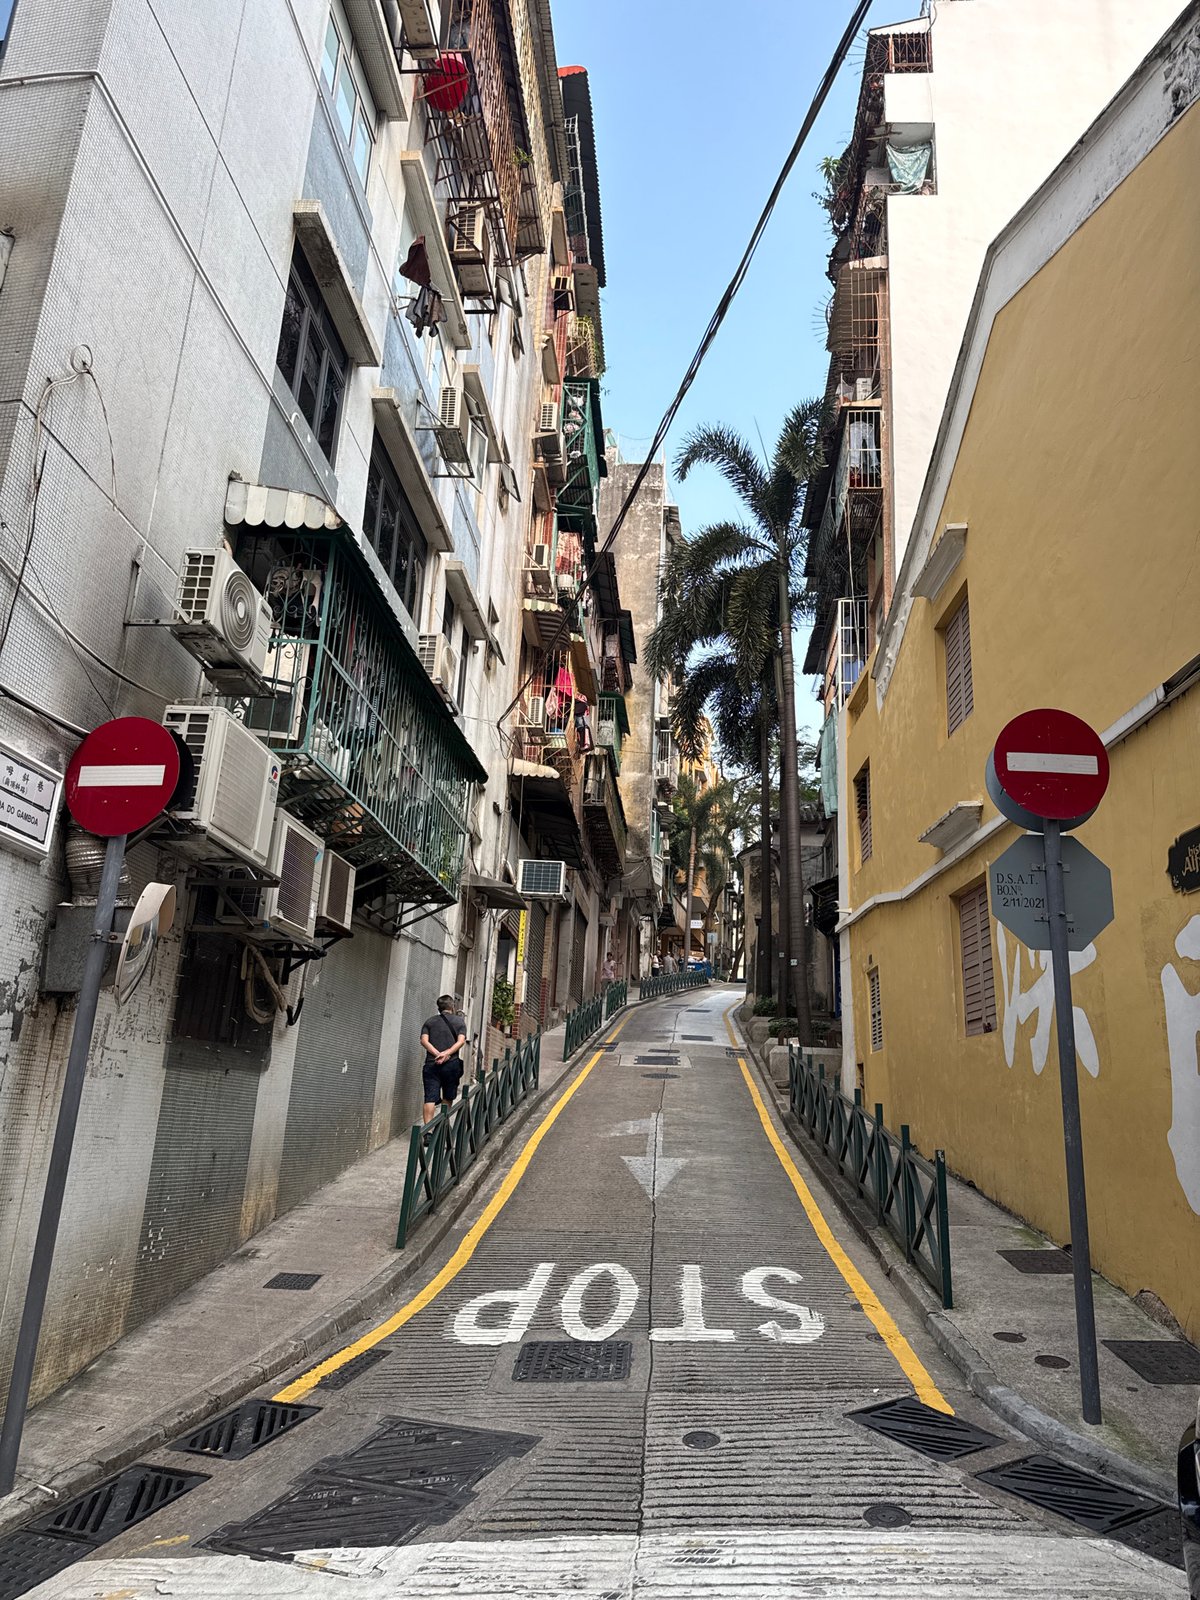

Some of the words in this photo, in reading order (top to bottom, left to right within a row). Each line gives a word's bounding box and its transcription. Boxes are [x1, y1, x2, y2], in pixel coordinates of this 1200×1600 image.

[7, 805, 15, 814] DO
[17, 810, 38, 826] GAMBOA
[996, 872, 1039, 885] D.S.A.T.
[449, 1262, 825, 1345] STOP
